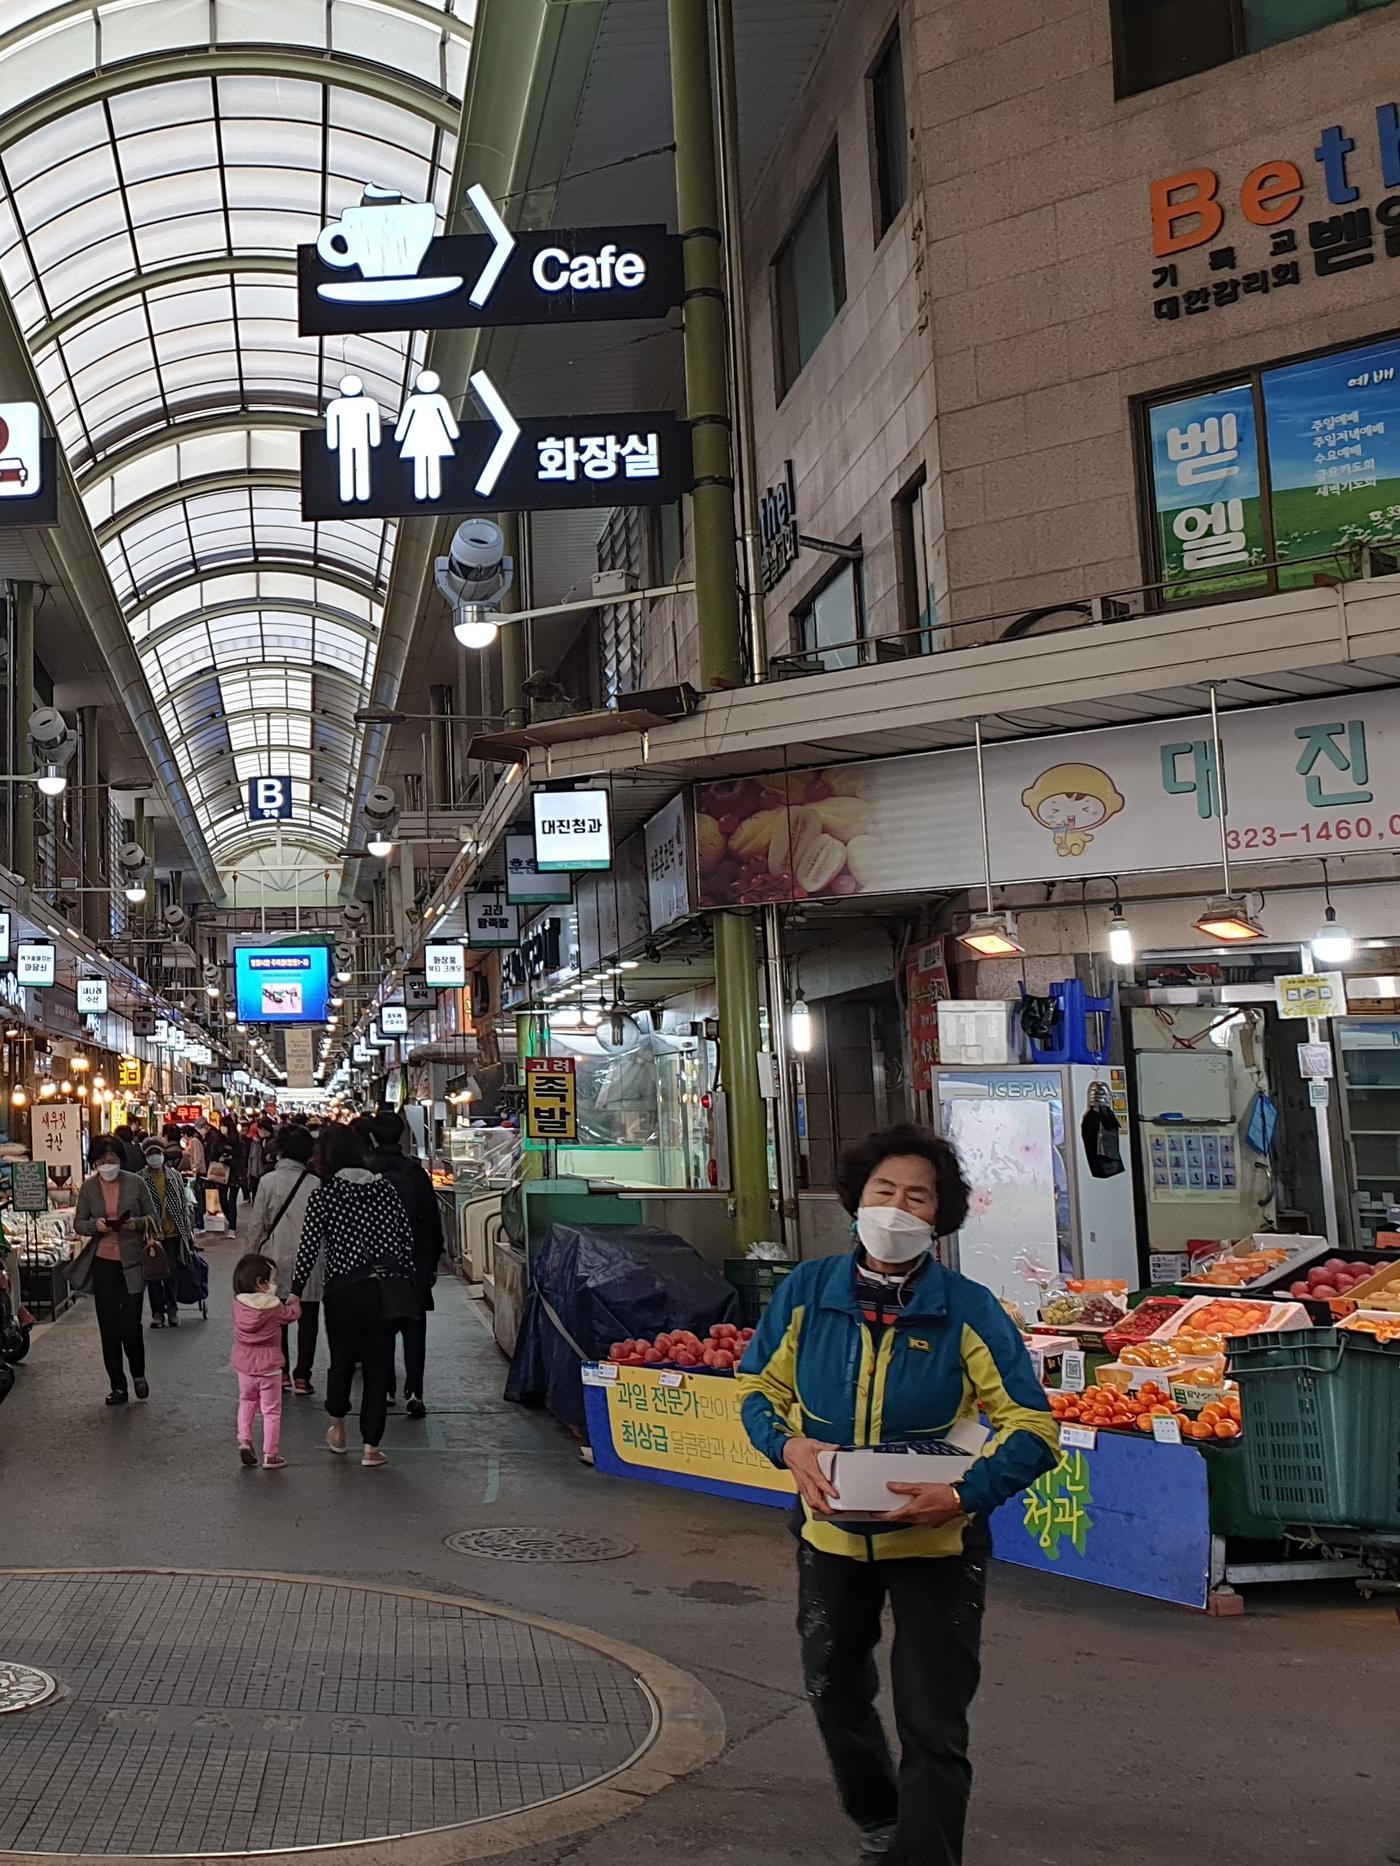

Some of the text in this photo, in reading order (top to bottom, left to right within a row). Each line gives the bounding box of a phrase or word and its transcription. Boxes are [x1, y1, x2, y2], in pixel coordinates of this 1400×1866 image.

[532, 244, 646, 291] Cafe
[1311, 409, 1360, 432] 주일예배
[1312, 421, 1385, 449] 주일저녁예배
[537, 433, 660, 481] 화장실
[257, 778, 284, 809] B
[541, 818, 602, 835] 대진청과
[433, 956, 457, 965] 화장품
[531, 1060, 570, 1073] 고려
[987, 1080, 1058, 1098] ICEPIA
[533, 1075, 570, 1134] 족발
[41, 1110, 67, 1130] 새우젓
[45, 1133, 64, 1152] 국산
[617, 1382, 649, 1412] 과일
[621, 1419, 669, 1453] 최상급
[1022, 1496, 1084, 1549] 청과
